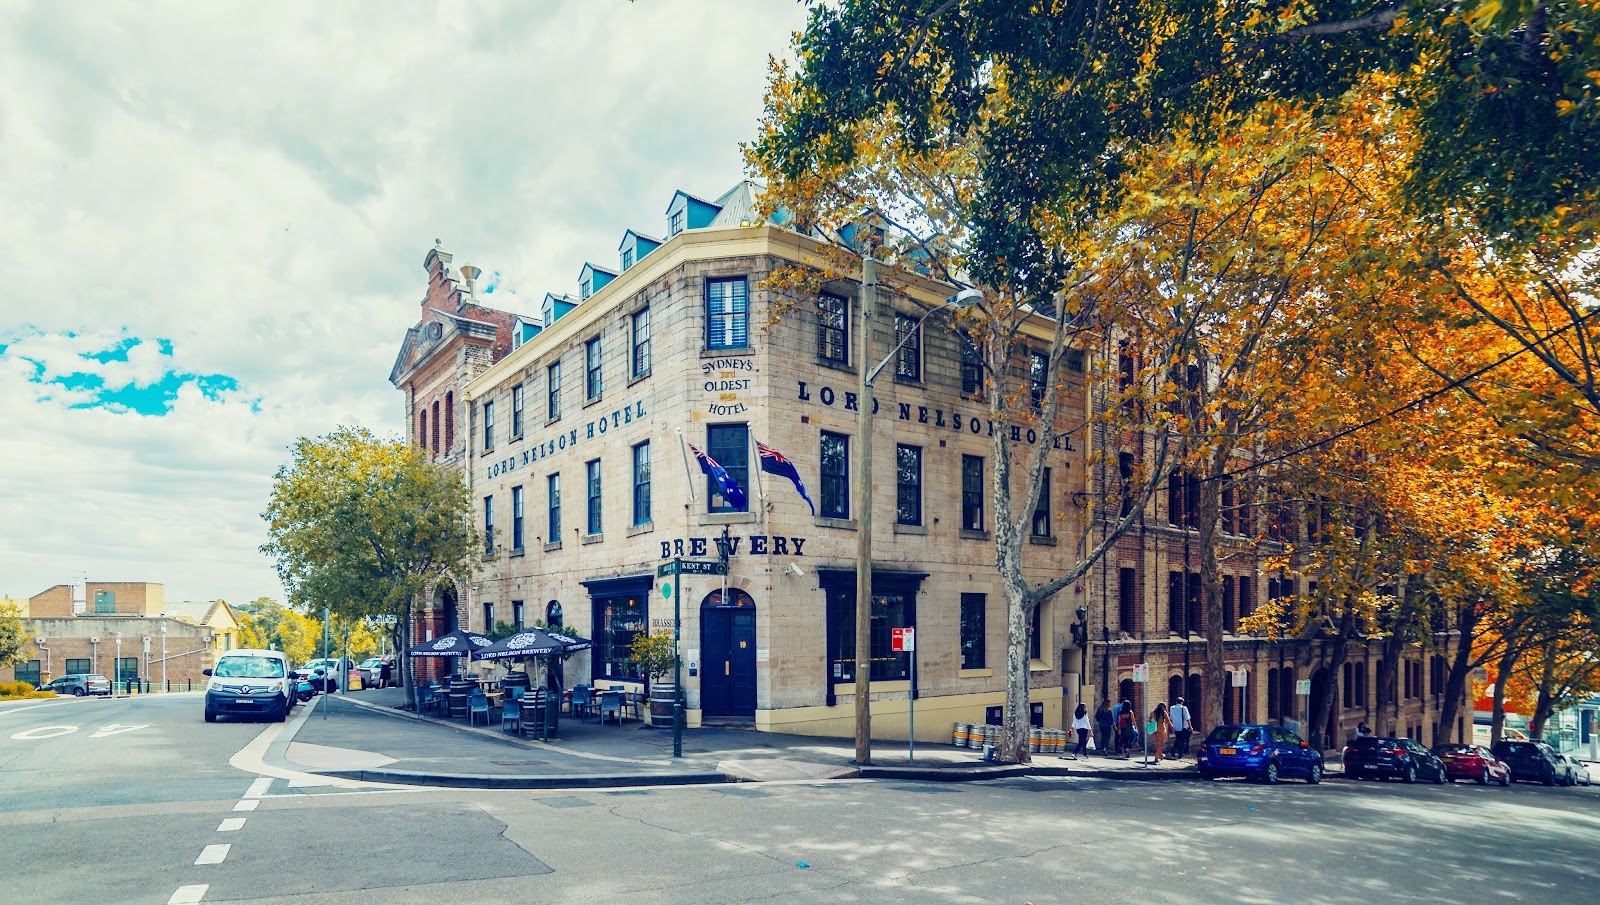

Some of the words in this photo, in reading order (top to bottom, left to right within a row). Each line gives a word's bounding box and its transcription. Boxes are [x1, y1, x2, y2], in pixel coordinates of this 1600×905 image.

[704, 379, 750, 392] OLDEST
[708, 402, 748, 416] HOTEL
[1010, 424, 1076, 452] HOEL.
[487, 456, 515, 480] LORD
[522, 428, 578, 466] NELSON
[660, 535, 806, 559] BREWERY
[681, 562, 701, 571] KENT
[702, 563, 712, 571] ST
[480, 651, 497, 660] LORD
[497, 649, 521, 658] NELSON
[521, 647, 552, 655] BREWERY
